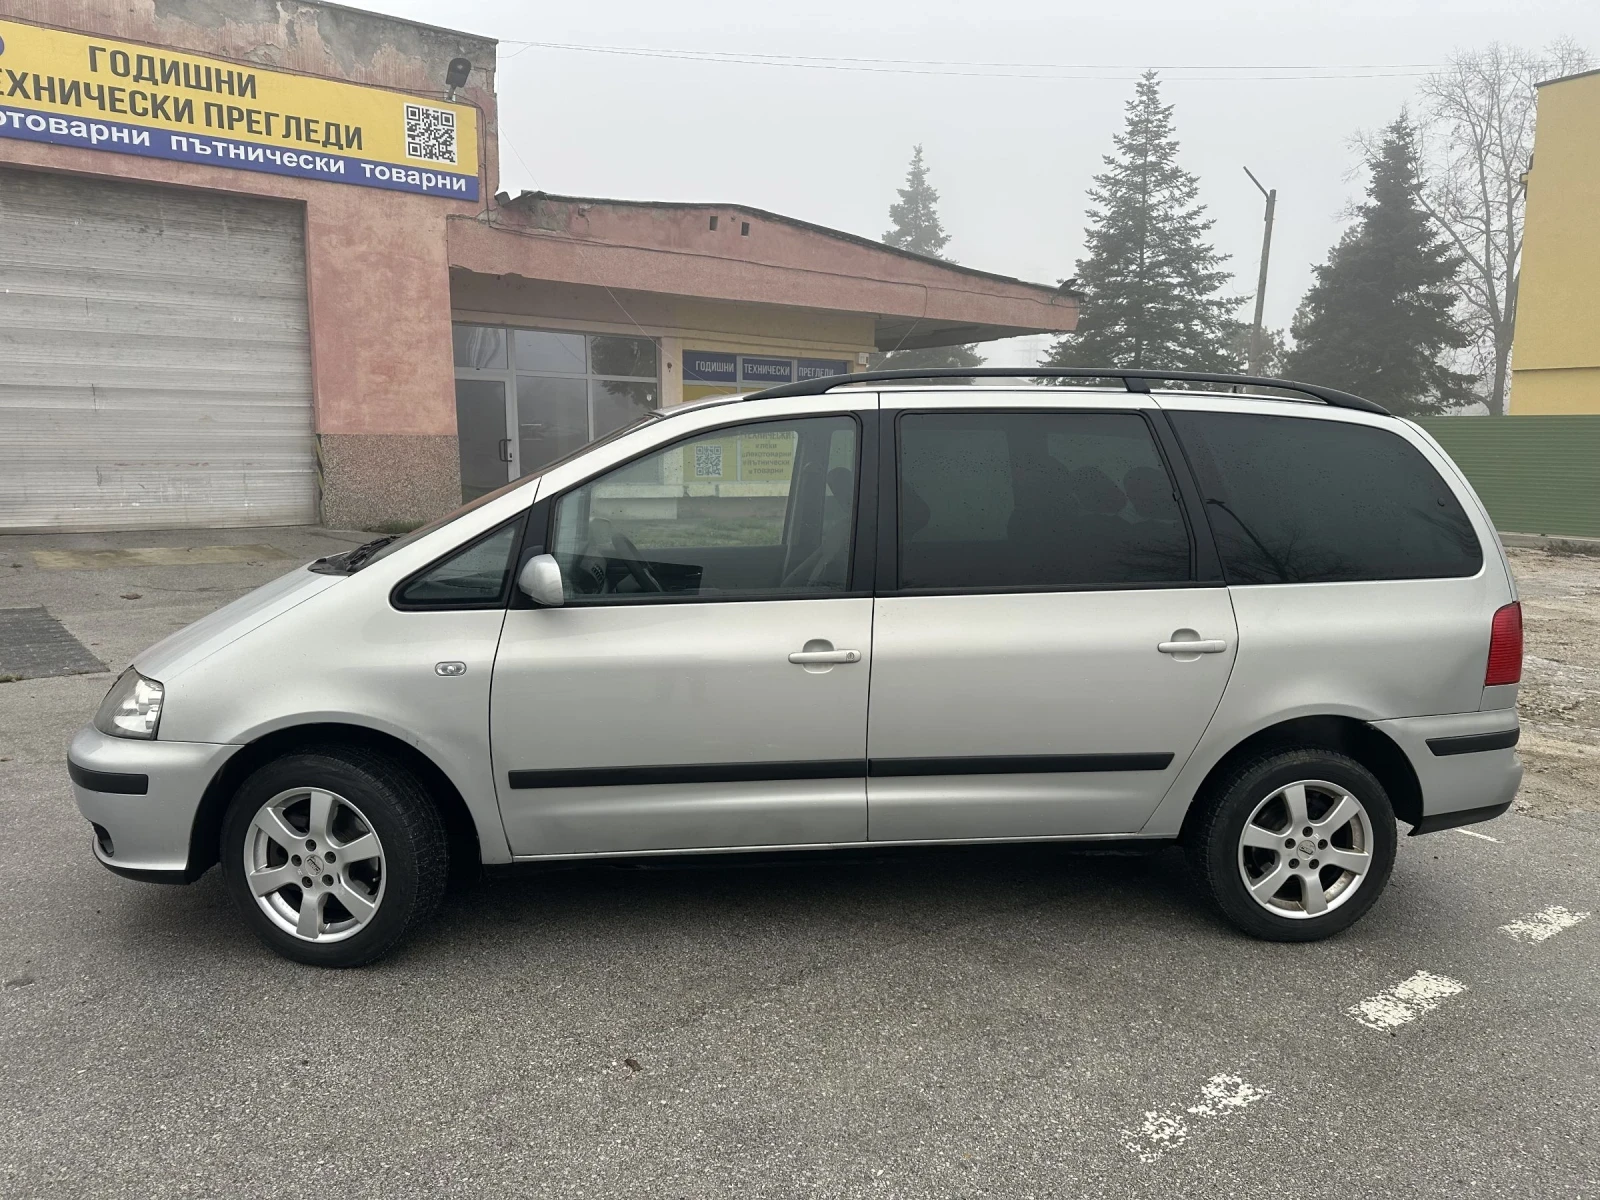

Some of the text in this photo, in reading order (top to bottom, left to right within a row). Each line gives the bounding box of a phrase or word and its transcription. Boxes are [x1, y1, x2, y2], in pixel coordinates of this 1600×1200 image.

[88, 45, 257, 99] ГОДИШНИ
[0, 67, 363, 151] ХНИЧЕСКИ ПРЕГЛЕДИ
[170, 135, 345, 174] пътнически
[361, 163, 466, 191] товарни
[695, 360, 834, 378] ГОДИШНИ ТЕХНИЧЕСКИ ПРЕГЛЕДИ
